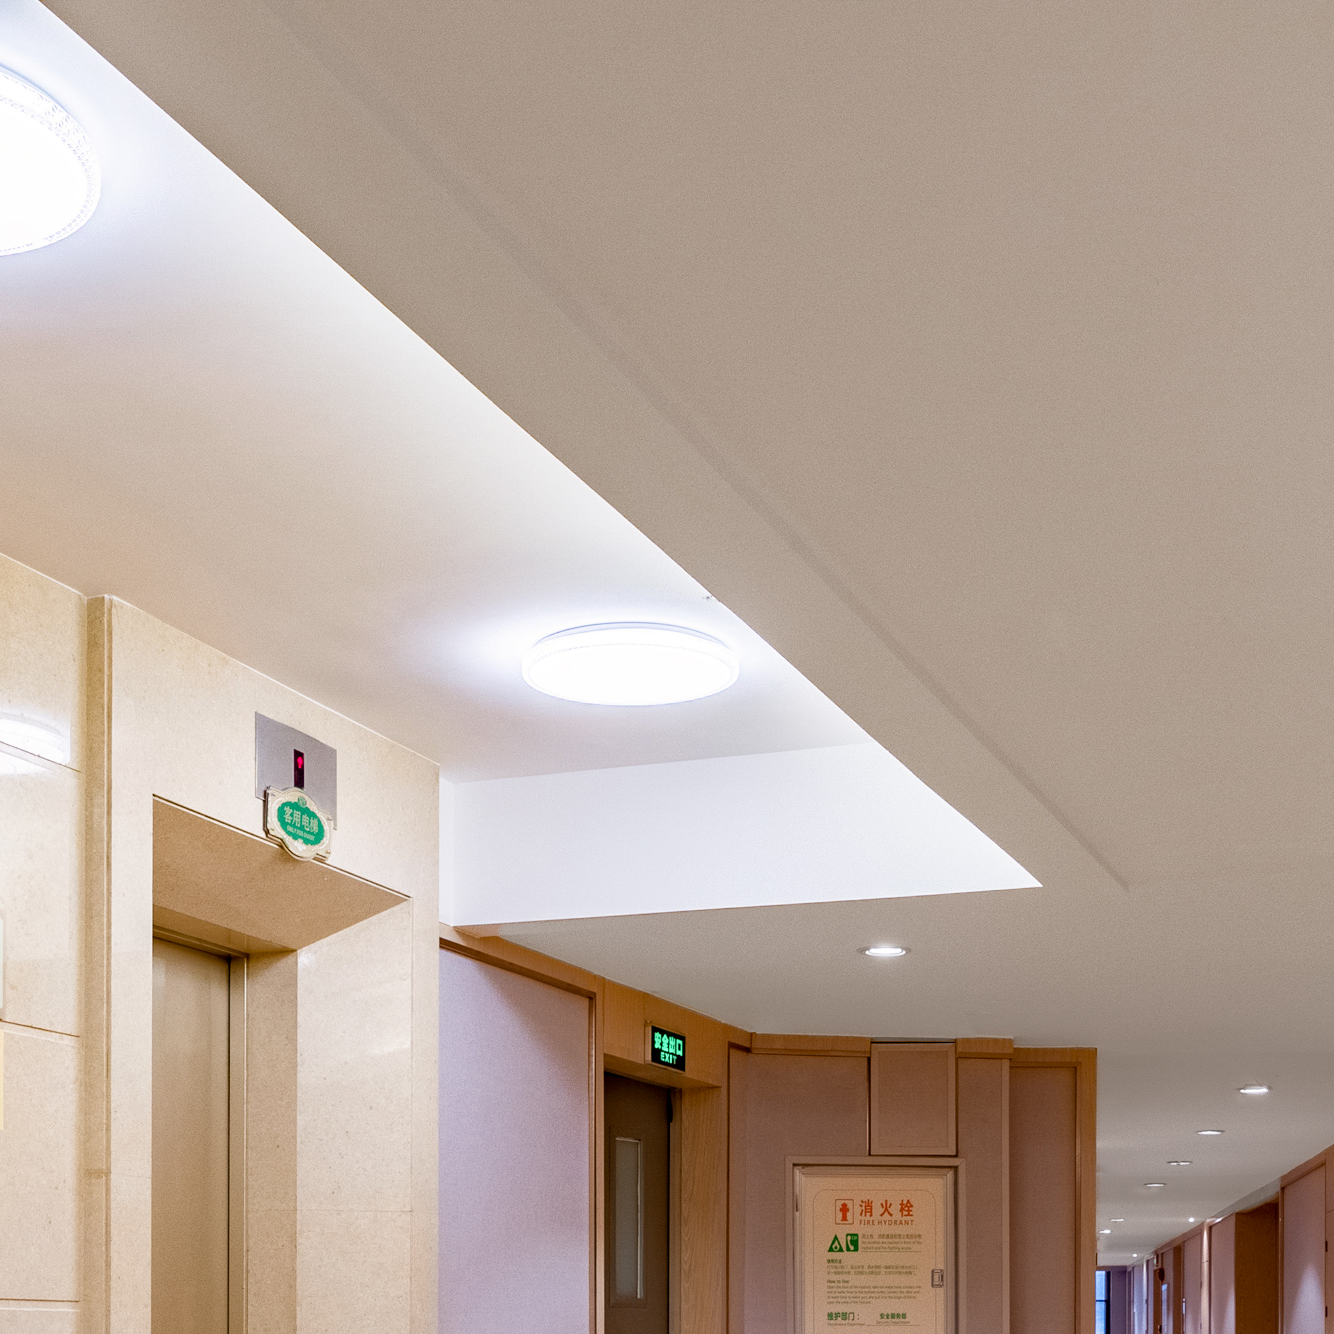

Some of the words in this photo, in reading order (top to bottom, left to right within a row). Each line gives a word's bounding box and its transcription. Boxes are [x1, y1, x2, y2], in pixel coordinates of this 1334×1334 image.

[283, 806, 319, 834] 客用电梯
[654, 1032, 683, 1056] 安全出口
[660, 1051, 677, 1064] EXIT
[859, 1199, 914, 1217] 消火栓
